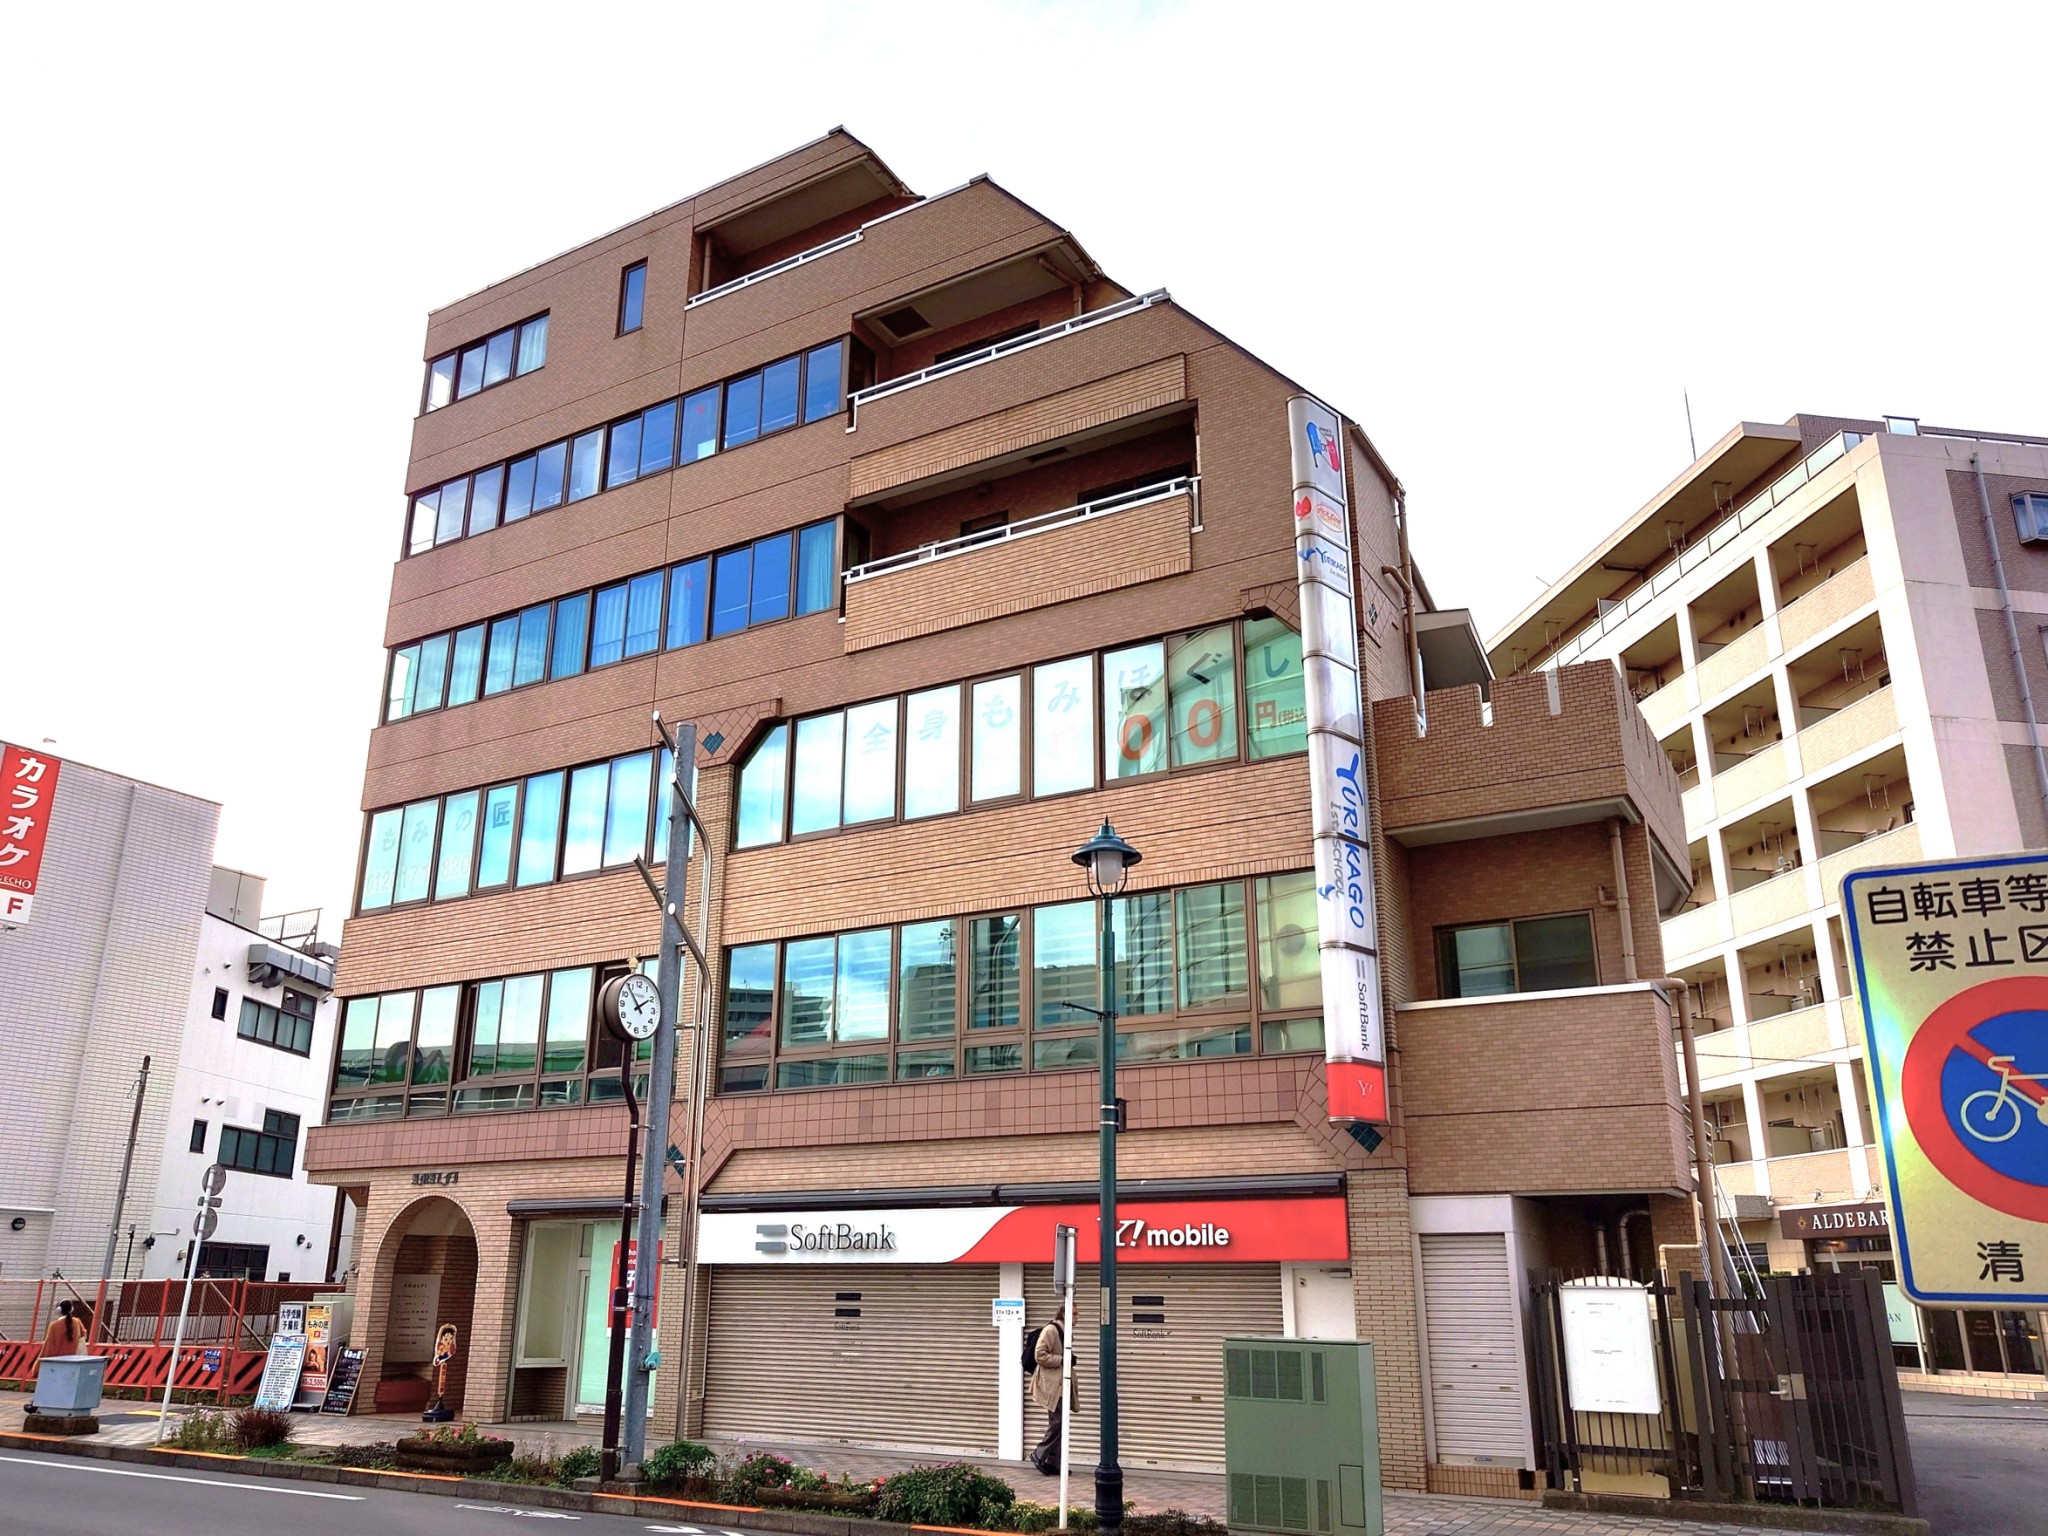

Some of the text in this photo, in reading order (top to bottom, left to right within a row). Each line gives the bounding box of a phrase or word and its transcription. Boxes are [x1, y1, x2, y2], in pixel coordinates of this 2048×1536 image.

[0, 757, 47, 867] カラオケ
[1336, 753, 1365, 929] YURIKAGO
[7, 897, 24, 914] F
[1868, 873, 2048, 926] 自転車等
[1906, 925, 2048, 972] 禁止区
[1357, 982, 1370, 1051] SoftBank
[1357, 1079, 1373, 1096] Y!
[790, 1223, 894, 1250] SoftBank
[1976, 1240, 2024, 1283] 清
